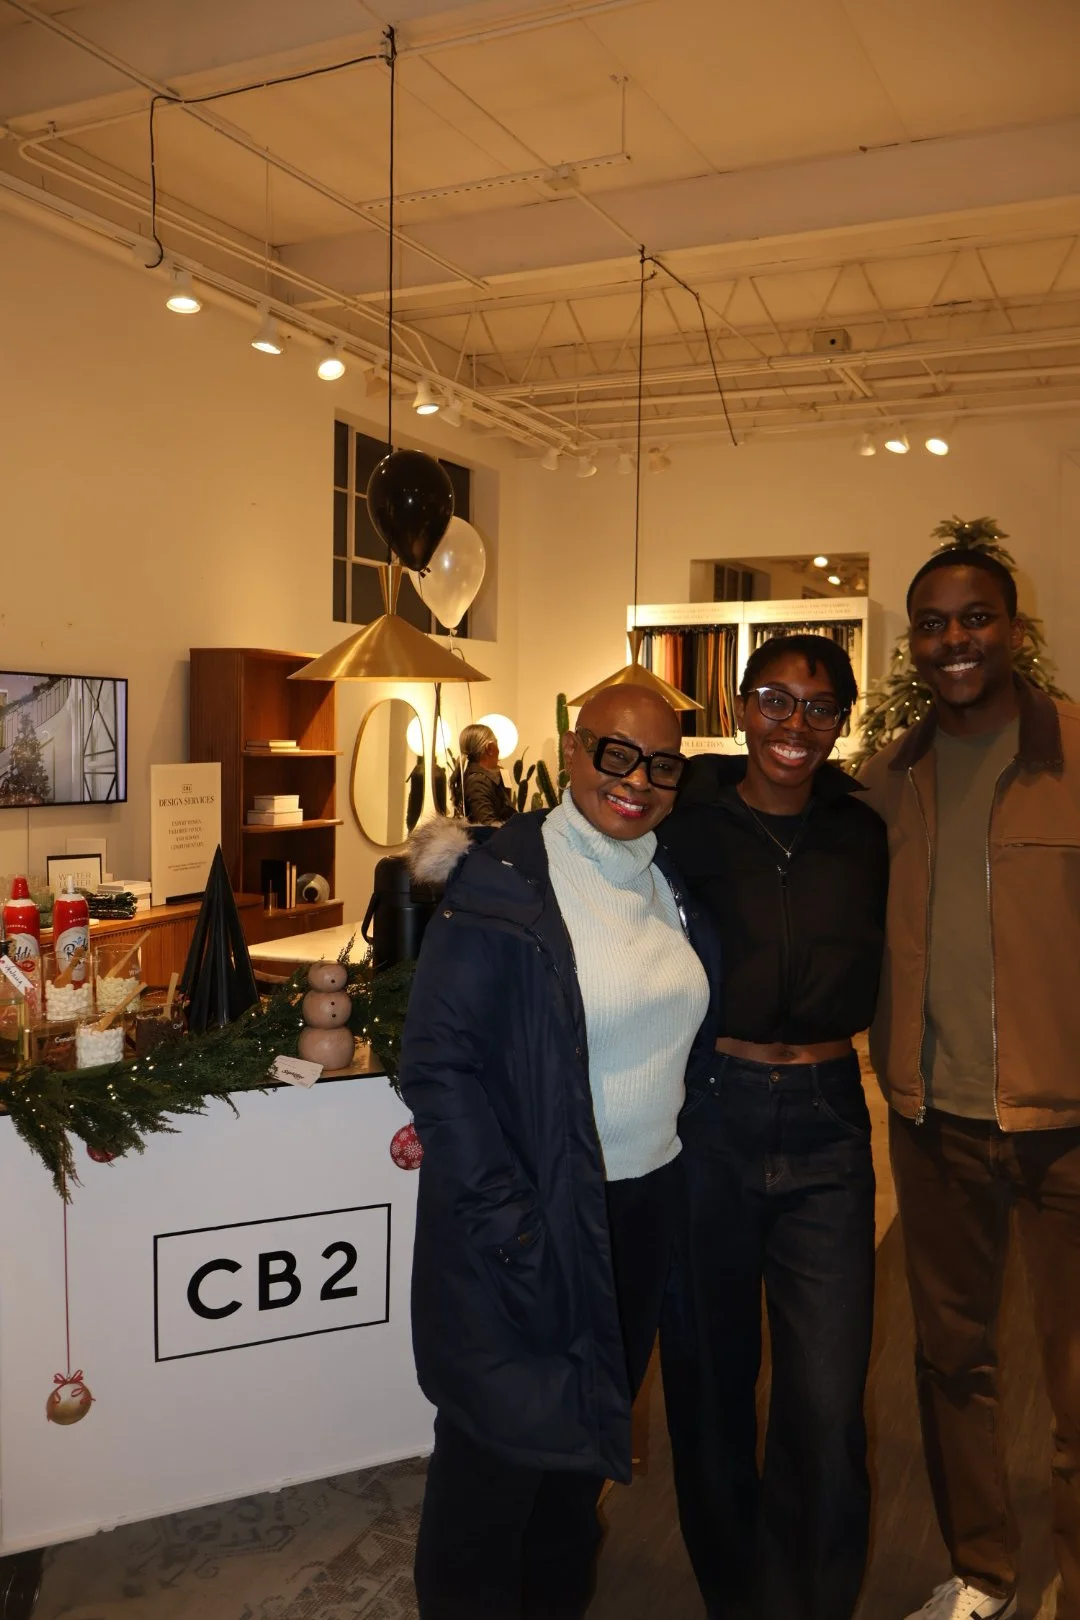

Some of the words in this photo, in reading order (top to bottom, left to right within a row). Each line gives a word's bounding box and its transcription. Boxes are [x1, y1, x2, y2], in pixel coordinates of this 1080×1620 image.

[159, 797, 183, 808] DESIGN
[184, 795, 215, 806] SERVICES
[187, 1241, 358, 1320] CB2
